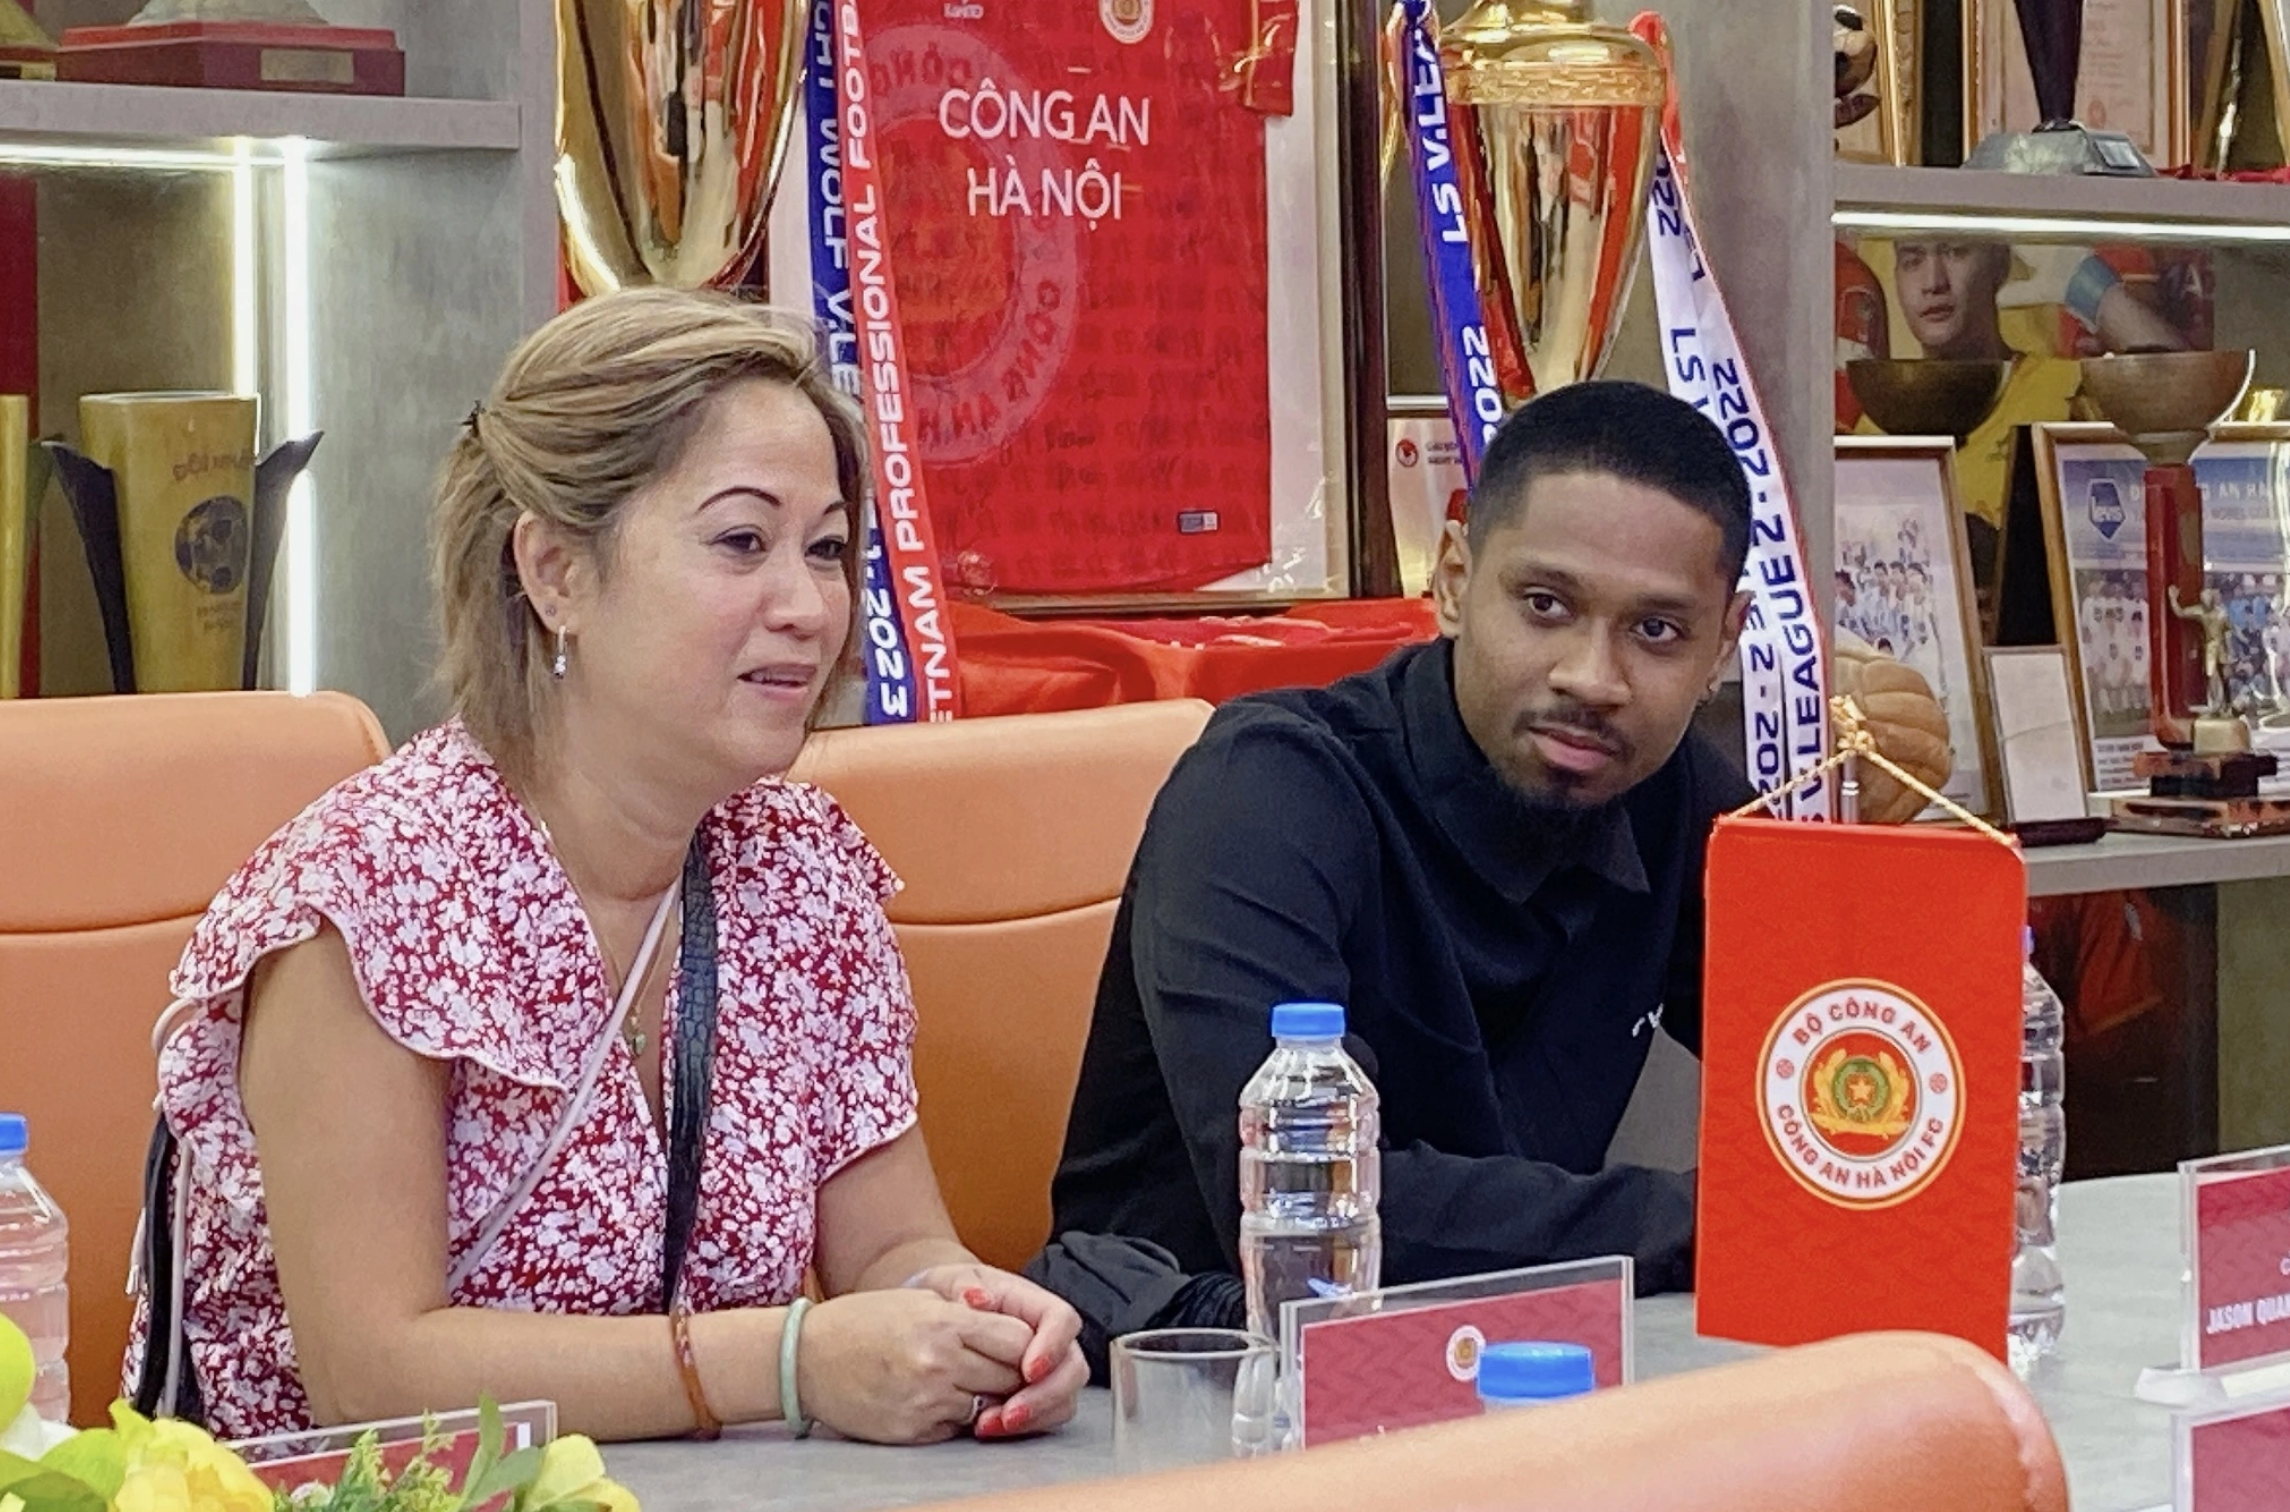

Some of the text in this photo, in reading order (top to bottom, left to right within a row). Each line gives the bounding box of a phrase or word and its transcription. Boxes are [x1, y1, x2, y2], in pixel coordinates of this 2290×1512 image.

[840, 0, 872, 169] FOOTB
[939, 77, 1150, 146] CÔNG AN
[967, 154, 1121, 231] HÀ NỘI
[1432, 183, 1470, 242] LS
[853, 184, 925, 552] PROFESSIONAL
[1670, 327, 1706, 383] LS
[1713, 358, 1770, 476] 2022
[1752, 514, 1786, 547] 2
[866, 588, 909, 717] 2023
[1750, 643, 1775, 673] 2
[1759, 555, 1822, 802] V.LEAGUE
[1755, 710, 1780, 819] 202
[1793, 997, 1932, 1055] BỘ CÔNG AN
[1777, 1104, 1945, 1189] CÔNG AN HÀ NỘI FC
